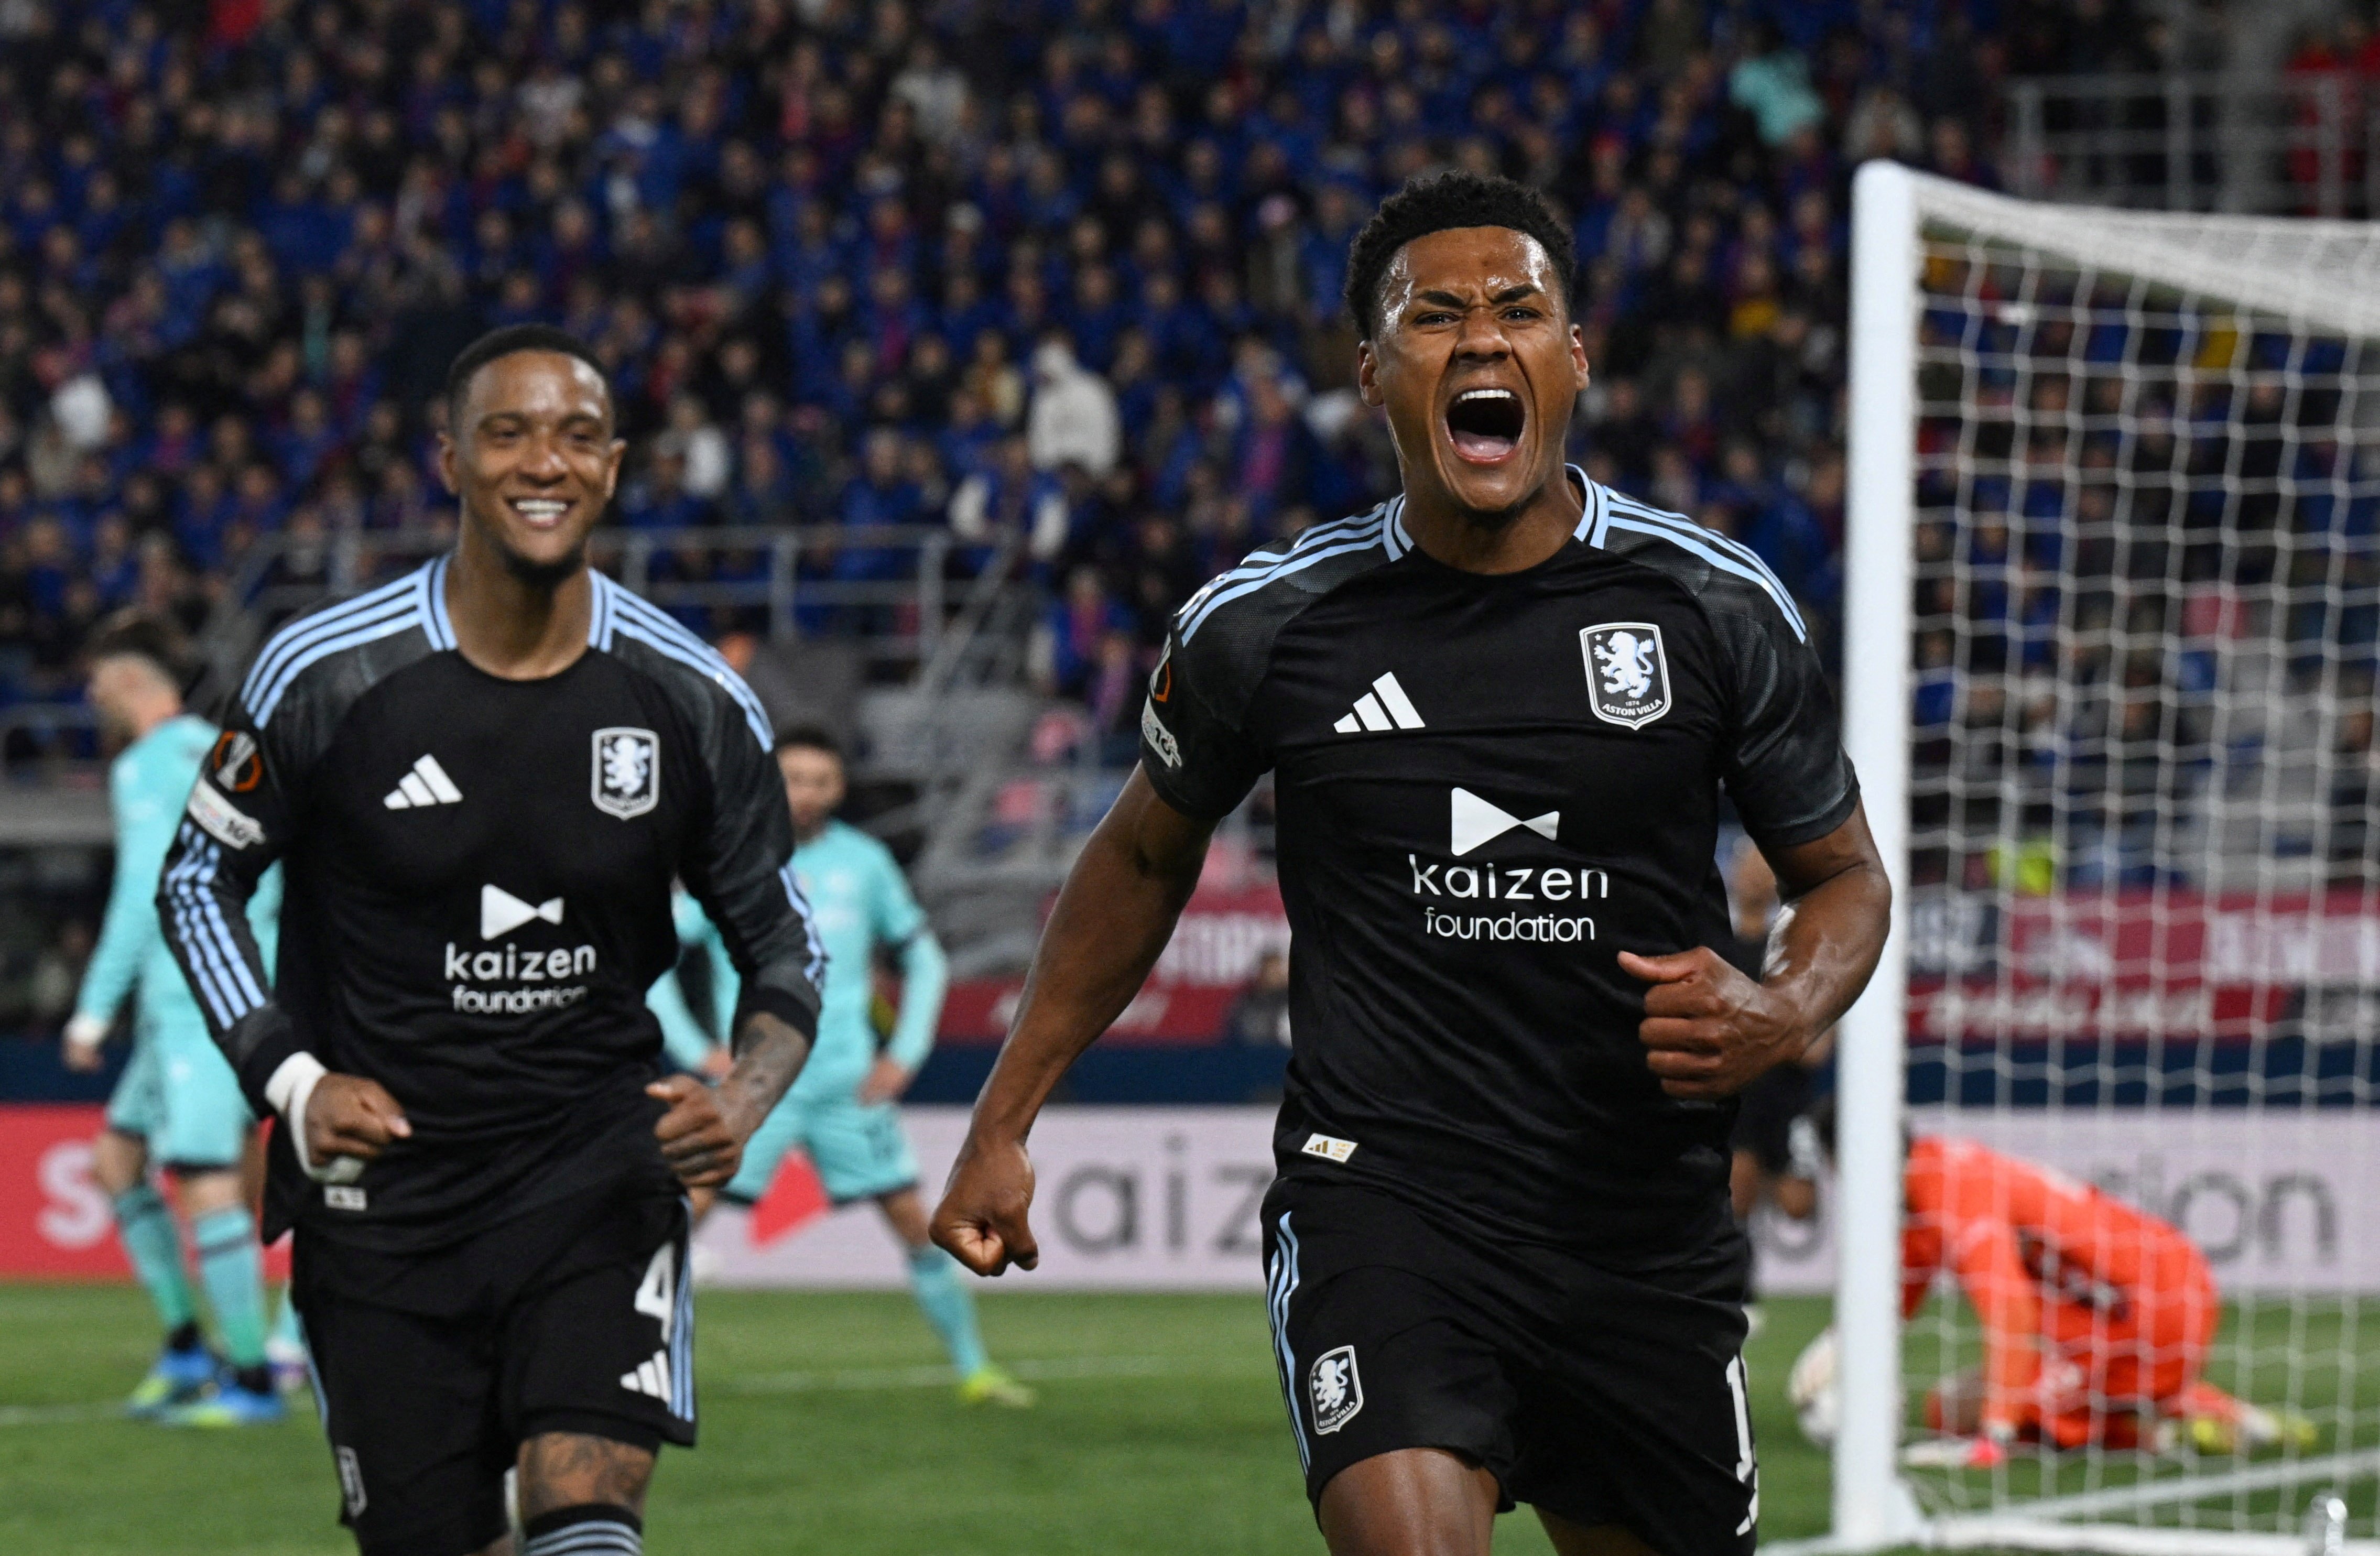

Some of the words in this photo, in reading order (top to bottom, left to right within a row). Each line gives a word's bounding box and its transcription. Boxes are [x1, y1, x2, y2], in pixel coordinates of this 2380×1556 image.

[1602, 703, 1636, 716] ASTON
[1636, 699, 1662, 715] VILLA
[1409, 854, 1608, 900] kaizen
[1425, 907, 1594, 942] foundation
[445, 942, 596, 981] kaizen
[635, 1241, 674, 1343] 4
[1336, 1401, 1355, 1419] VILLA
